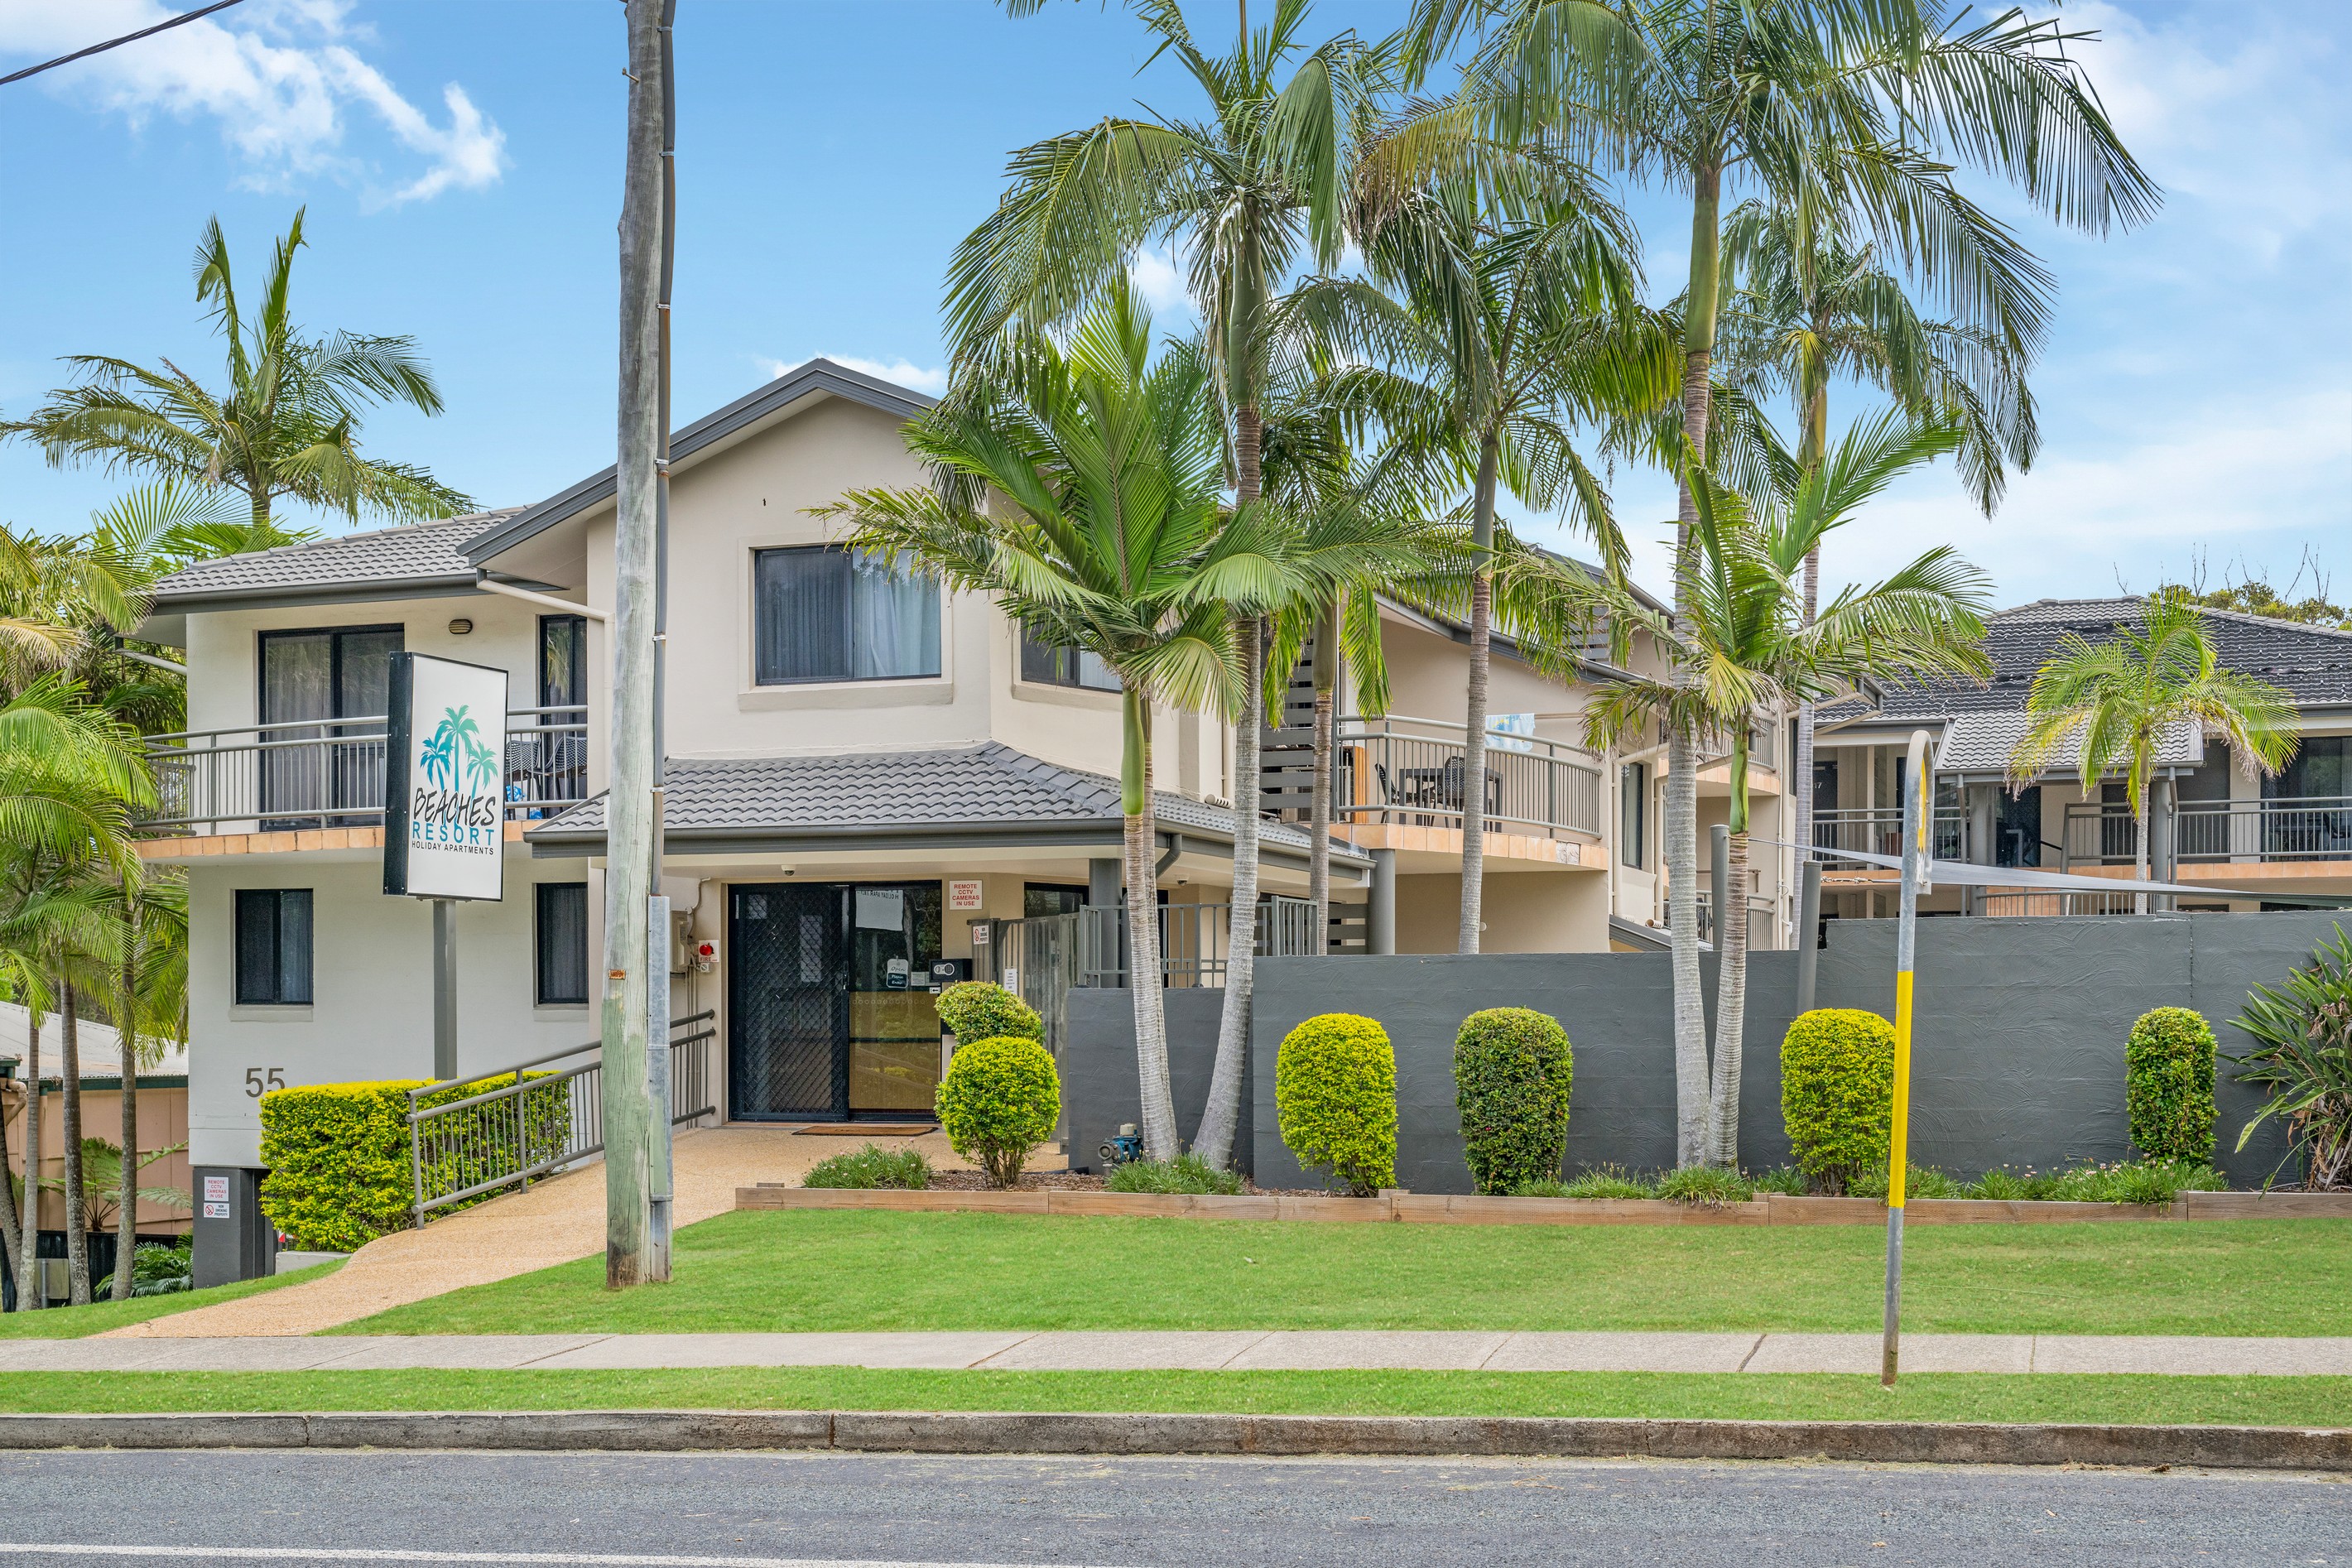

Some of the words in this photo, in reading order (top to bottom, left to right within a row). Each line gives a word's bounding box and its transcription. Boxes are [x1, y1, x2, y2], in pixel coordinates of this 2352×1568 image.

[414, 787, 496, 827] BEACHES
[412, 821, 494, 846] RESORT
[411, 840, 442, 850] HOLIDAY
[444, 844, 494, 855] APARTMENTS
[245, 1068, 286, 1098] 55
